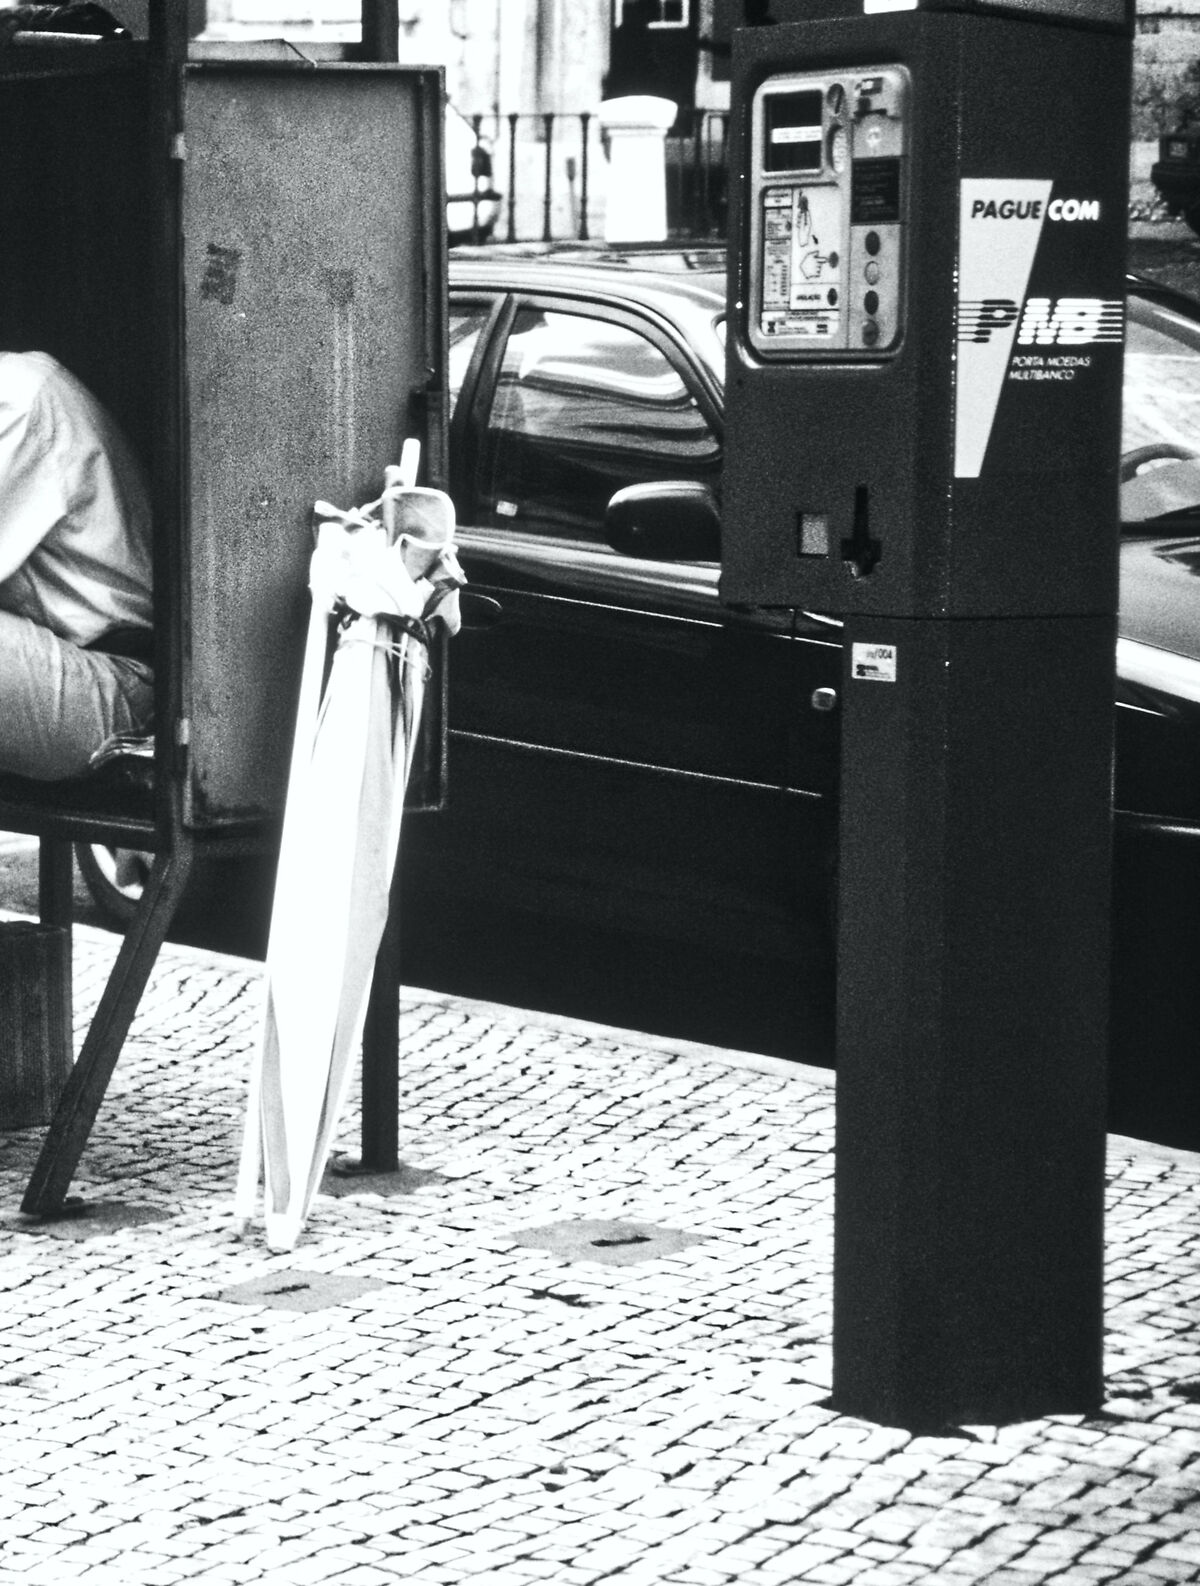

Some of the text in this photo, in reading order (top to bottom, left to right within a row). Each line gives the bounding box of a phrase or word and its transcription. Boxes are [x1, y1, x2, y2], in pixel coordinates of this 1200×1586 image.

[972, 199, 1100, 221] PAGUE COM
[958, 298, 1124, 345] PMB
[1011, 355, 1091, 367] PORTA MOEDAS
[1008, 370, 1075, 381] MULTIBANCO
